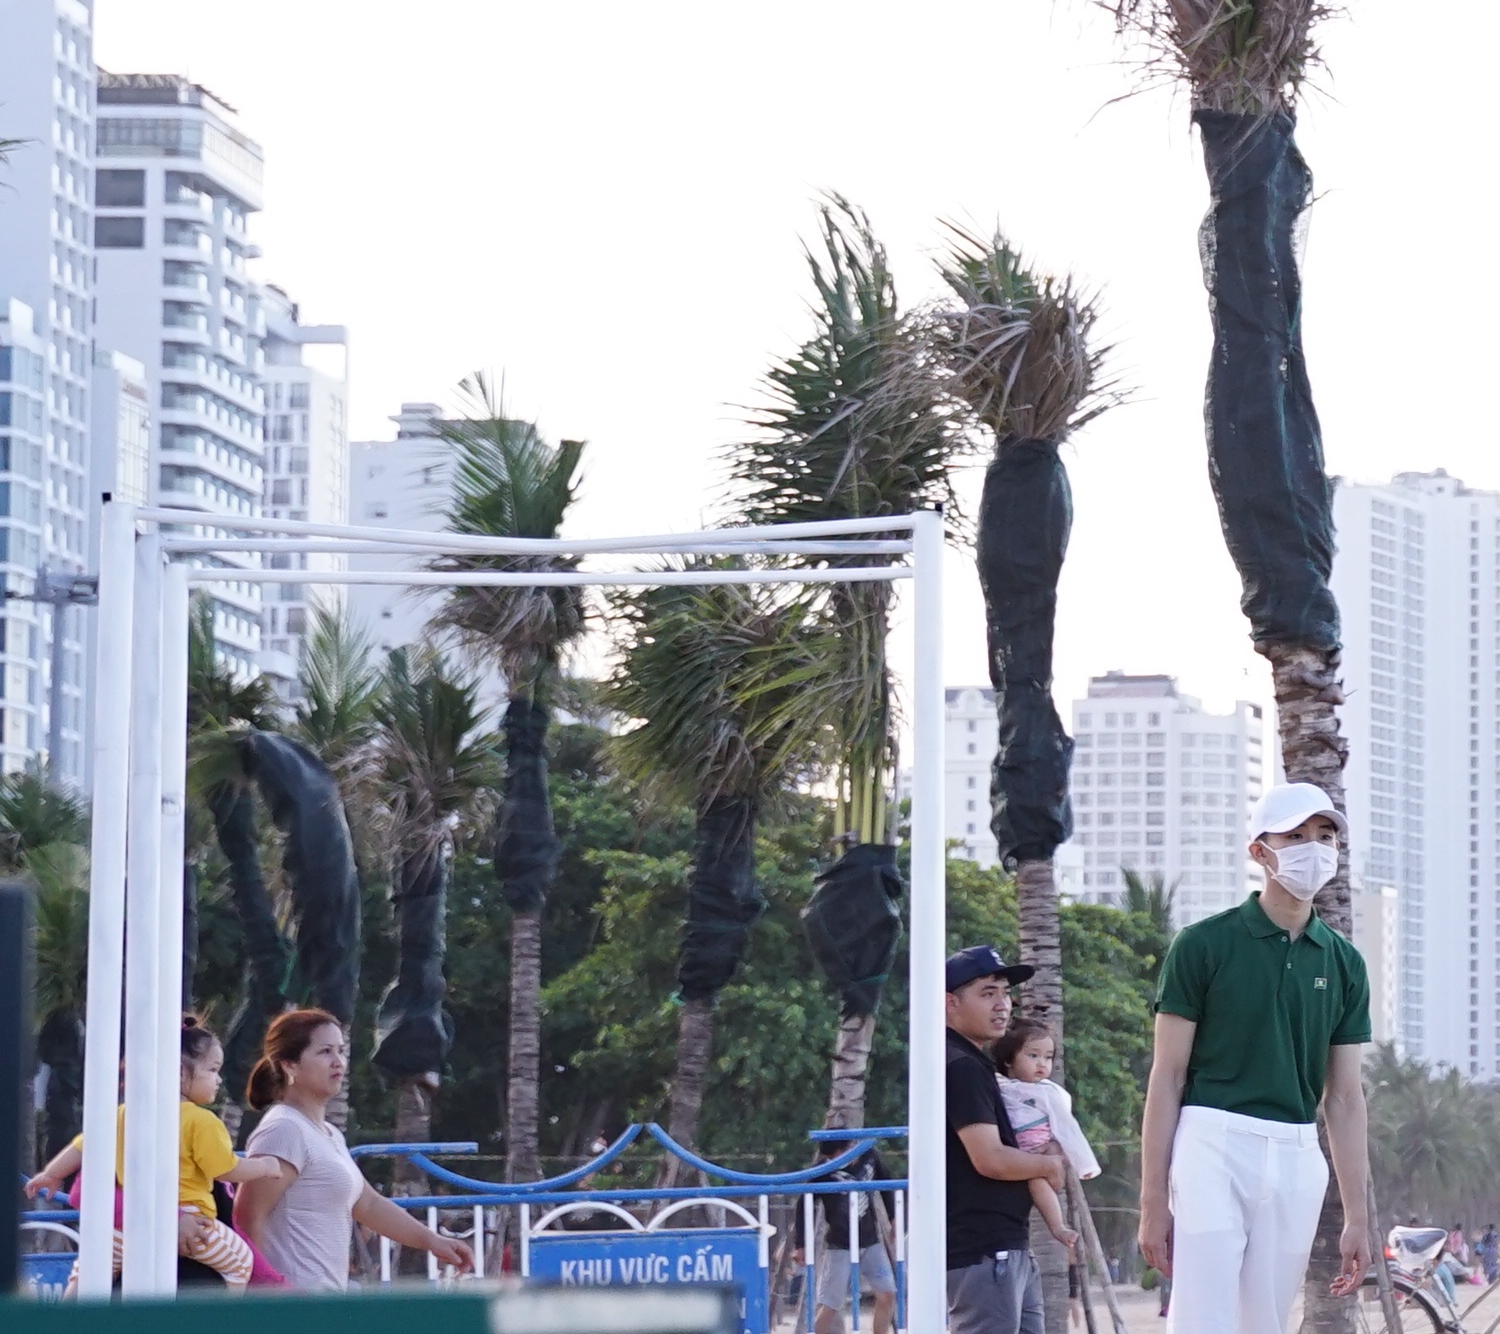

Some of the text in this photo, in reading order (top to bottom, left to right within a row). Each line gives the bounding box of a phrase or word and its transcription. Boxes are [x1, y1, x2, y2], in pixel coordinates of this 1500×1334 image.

[561, 1244, 734, 1289] KHU VỰC CẤM
